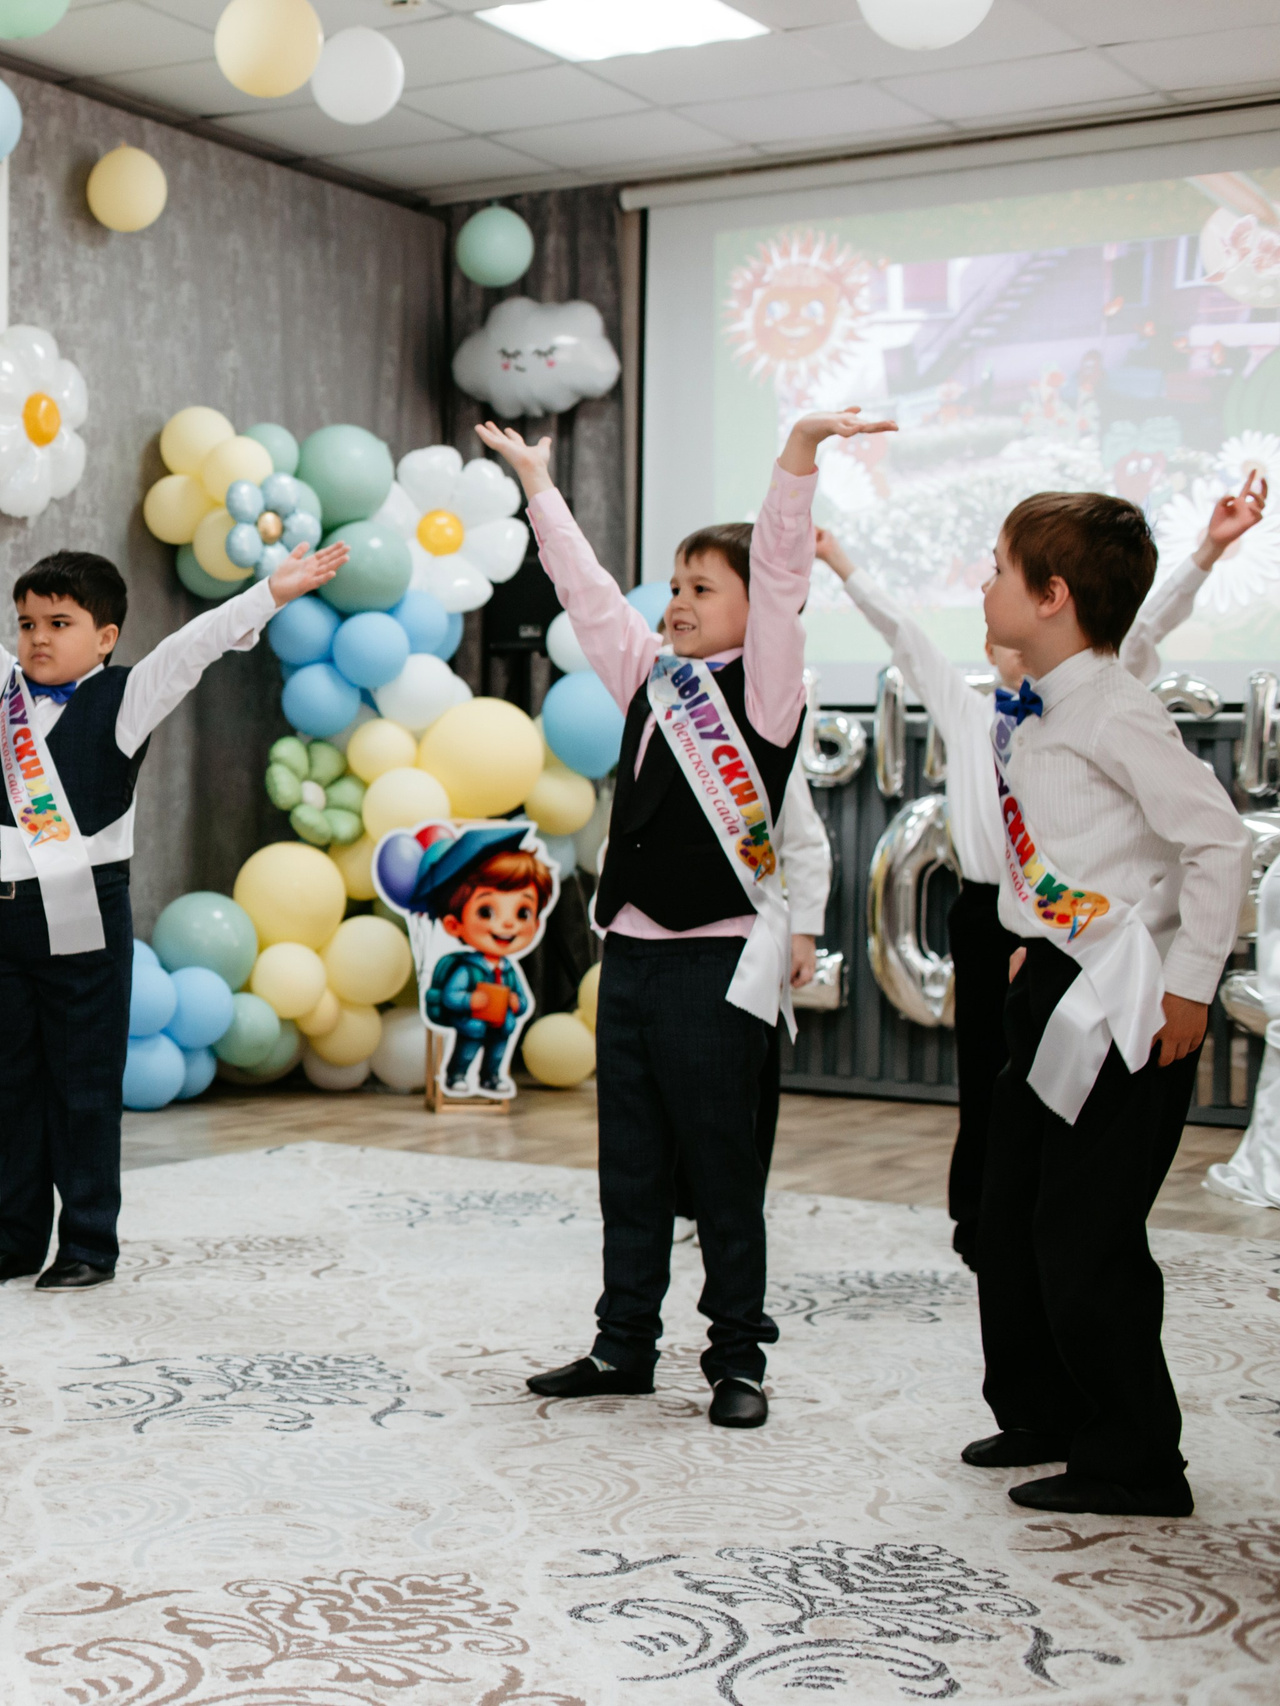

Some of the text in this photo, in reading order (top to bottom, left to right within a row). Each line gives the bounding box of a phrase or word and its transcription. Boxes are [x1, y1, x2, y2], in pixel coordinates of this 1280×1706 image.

[0, 711, 24, 804] детского сада
[8, 668, 57, 814] ЫПУСКНИК
[670, 662, 770, 846] ВЫПУСКНИК
[672, 720, 740, 836] детского сада
[1009, 862, 1029, 902] сада
